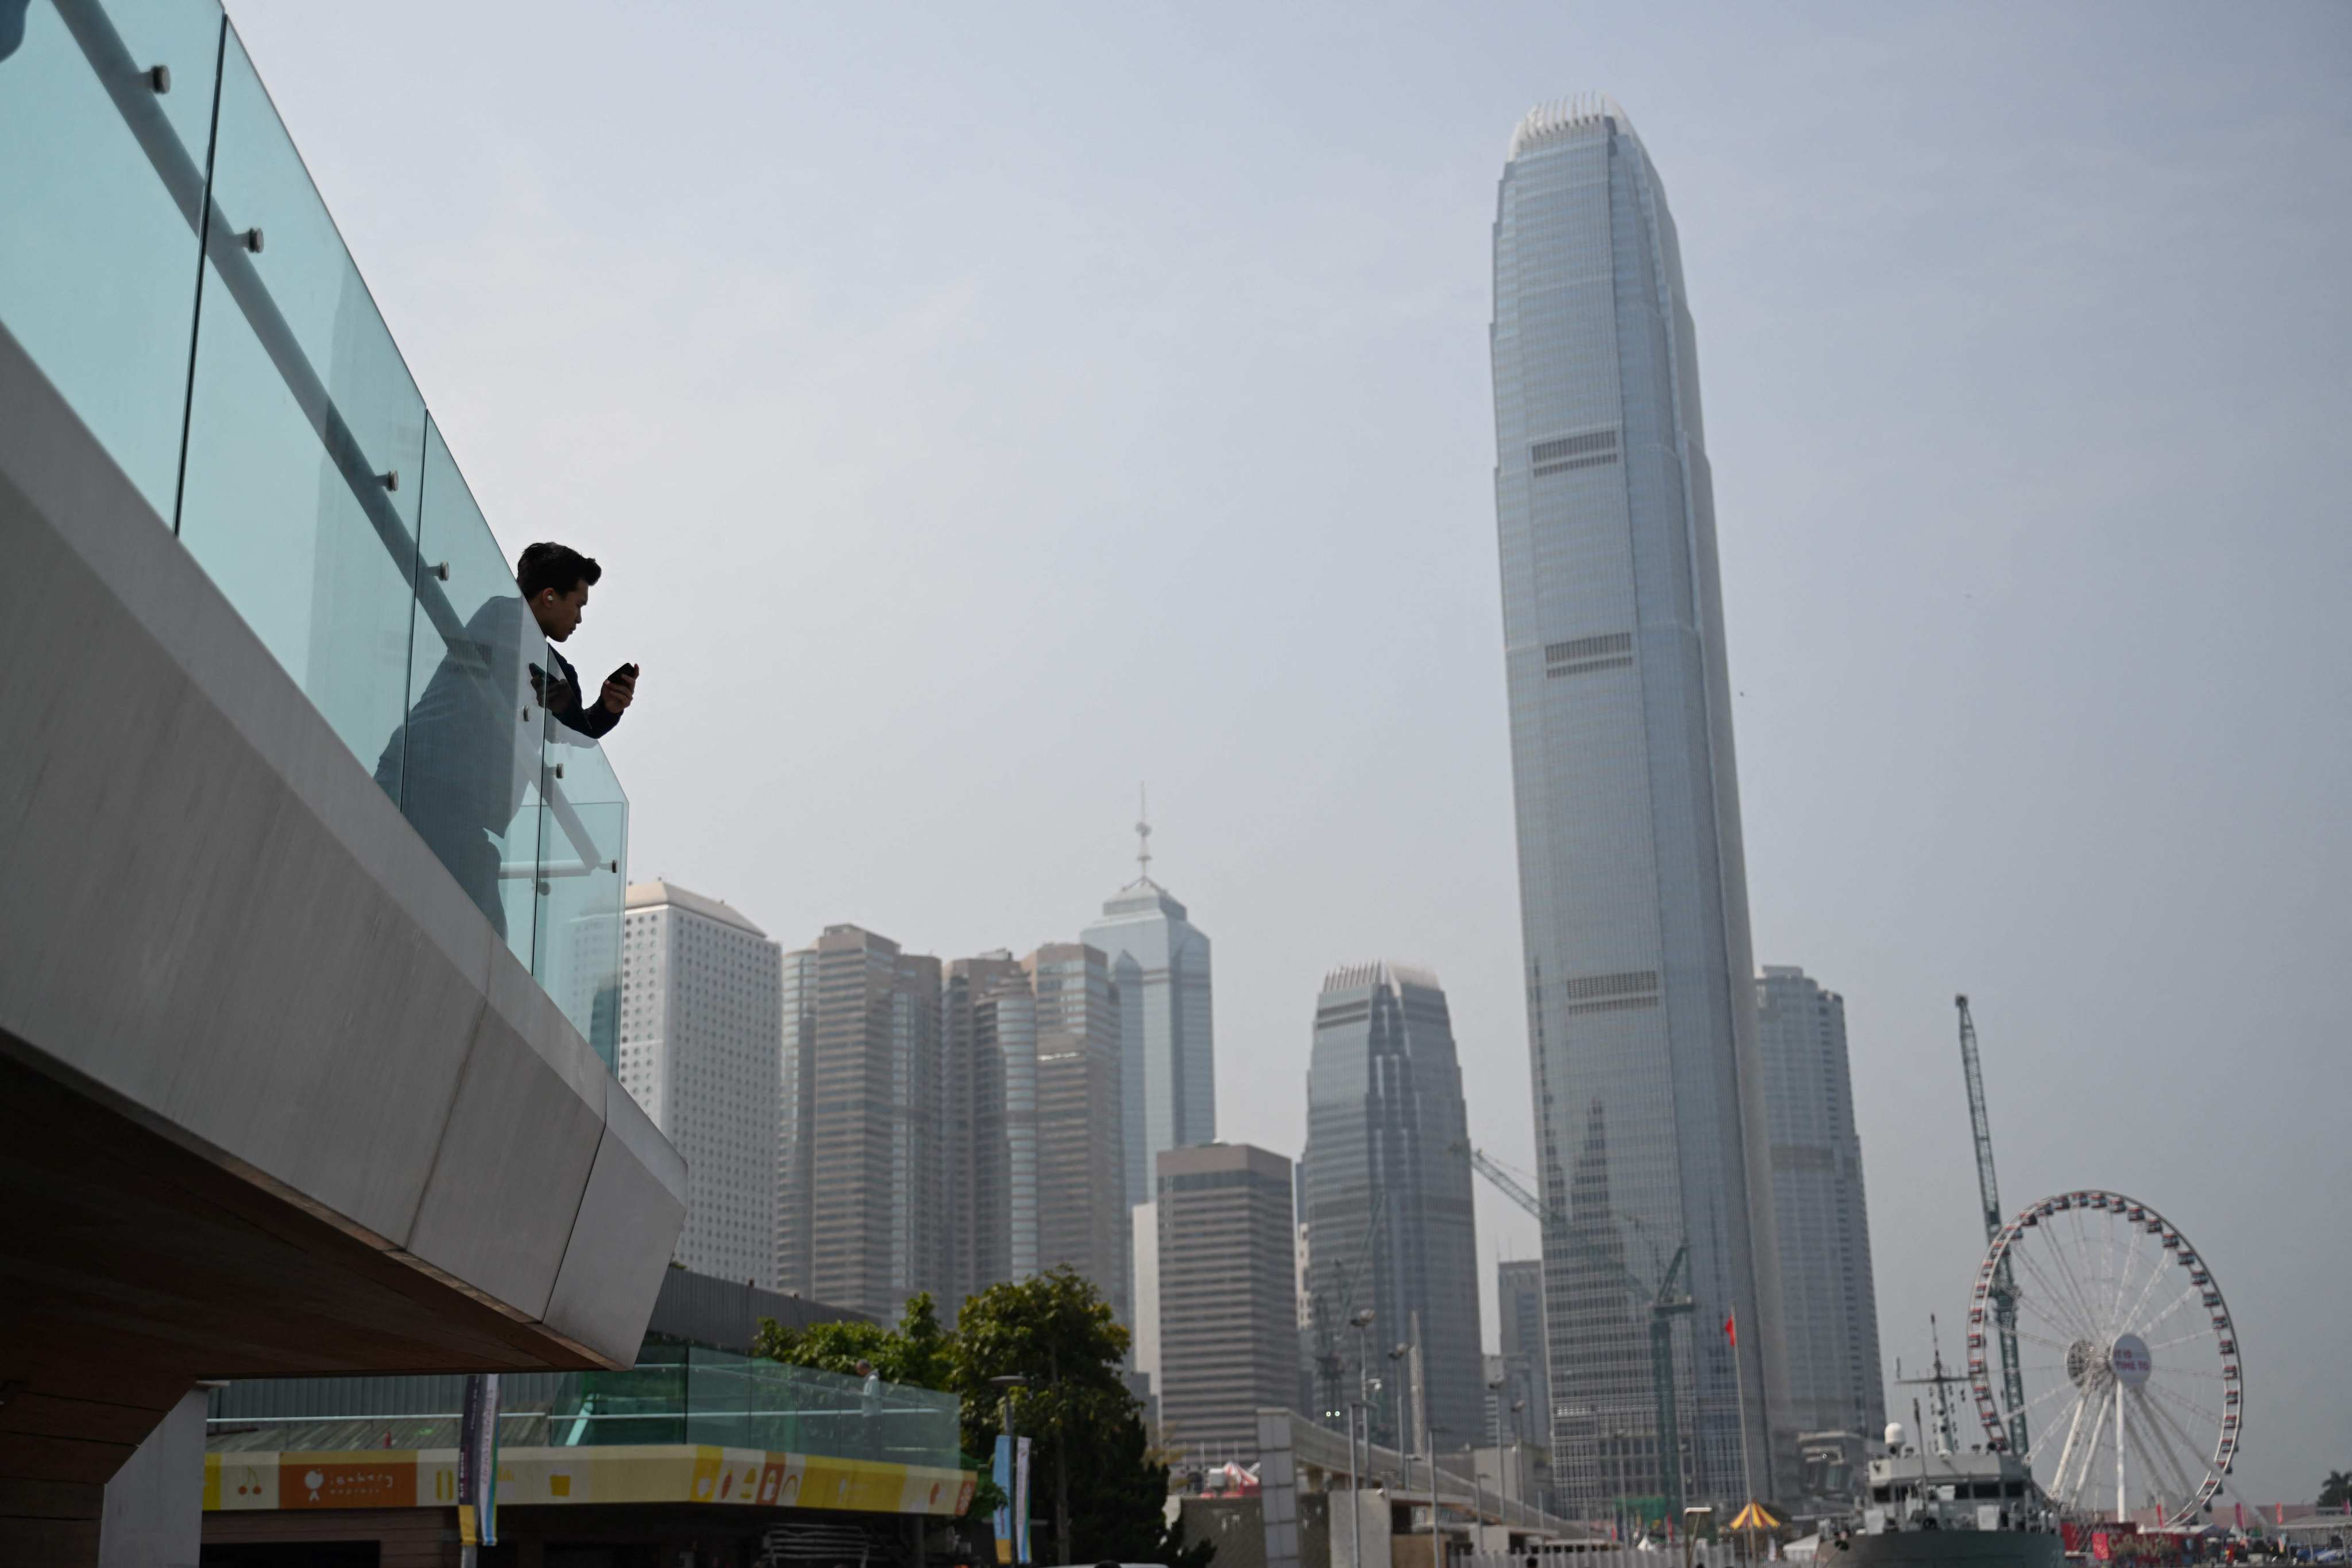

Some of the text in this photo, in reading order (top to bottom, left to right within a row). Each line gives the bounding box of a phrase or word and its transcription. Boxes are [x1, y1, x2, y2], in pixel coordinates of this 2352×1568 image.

[2114, 1350, 2132, 1360] IT IS
[2116, 1361, 2136, 1370] TIME
